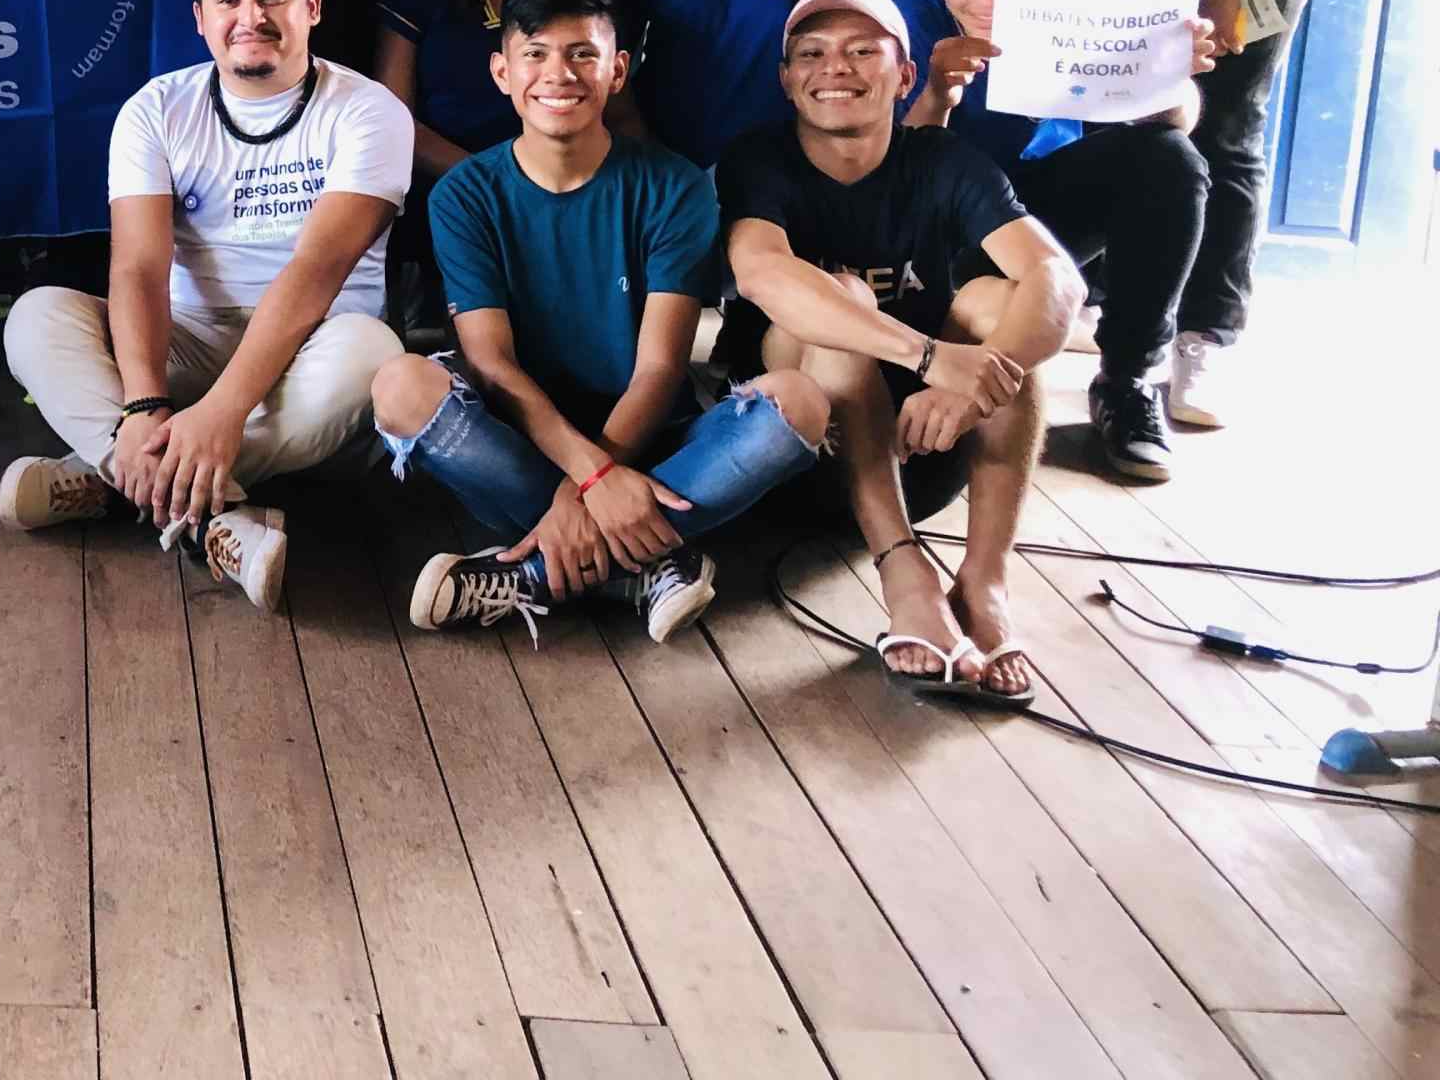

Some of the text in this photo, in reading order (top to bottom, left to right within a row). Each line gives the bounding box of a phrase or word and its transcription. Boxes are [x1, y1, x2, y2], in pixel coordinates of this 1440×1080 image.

[1052, 35, 1148, 52] NA ESCOLA
[1055, 60, 1140, 77] É AGORA!
[235, 156, 324, 181] um mundo de
[233, 177, 326, 202] pessoas que
